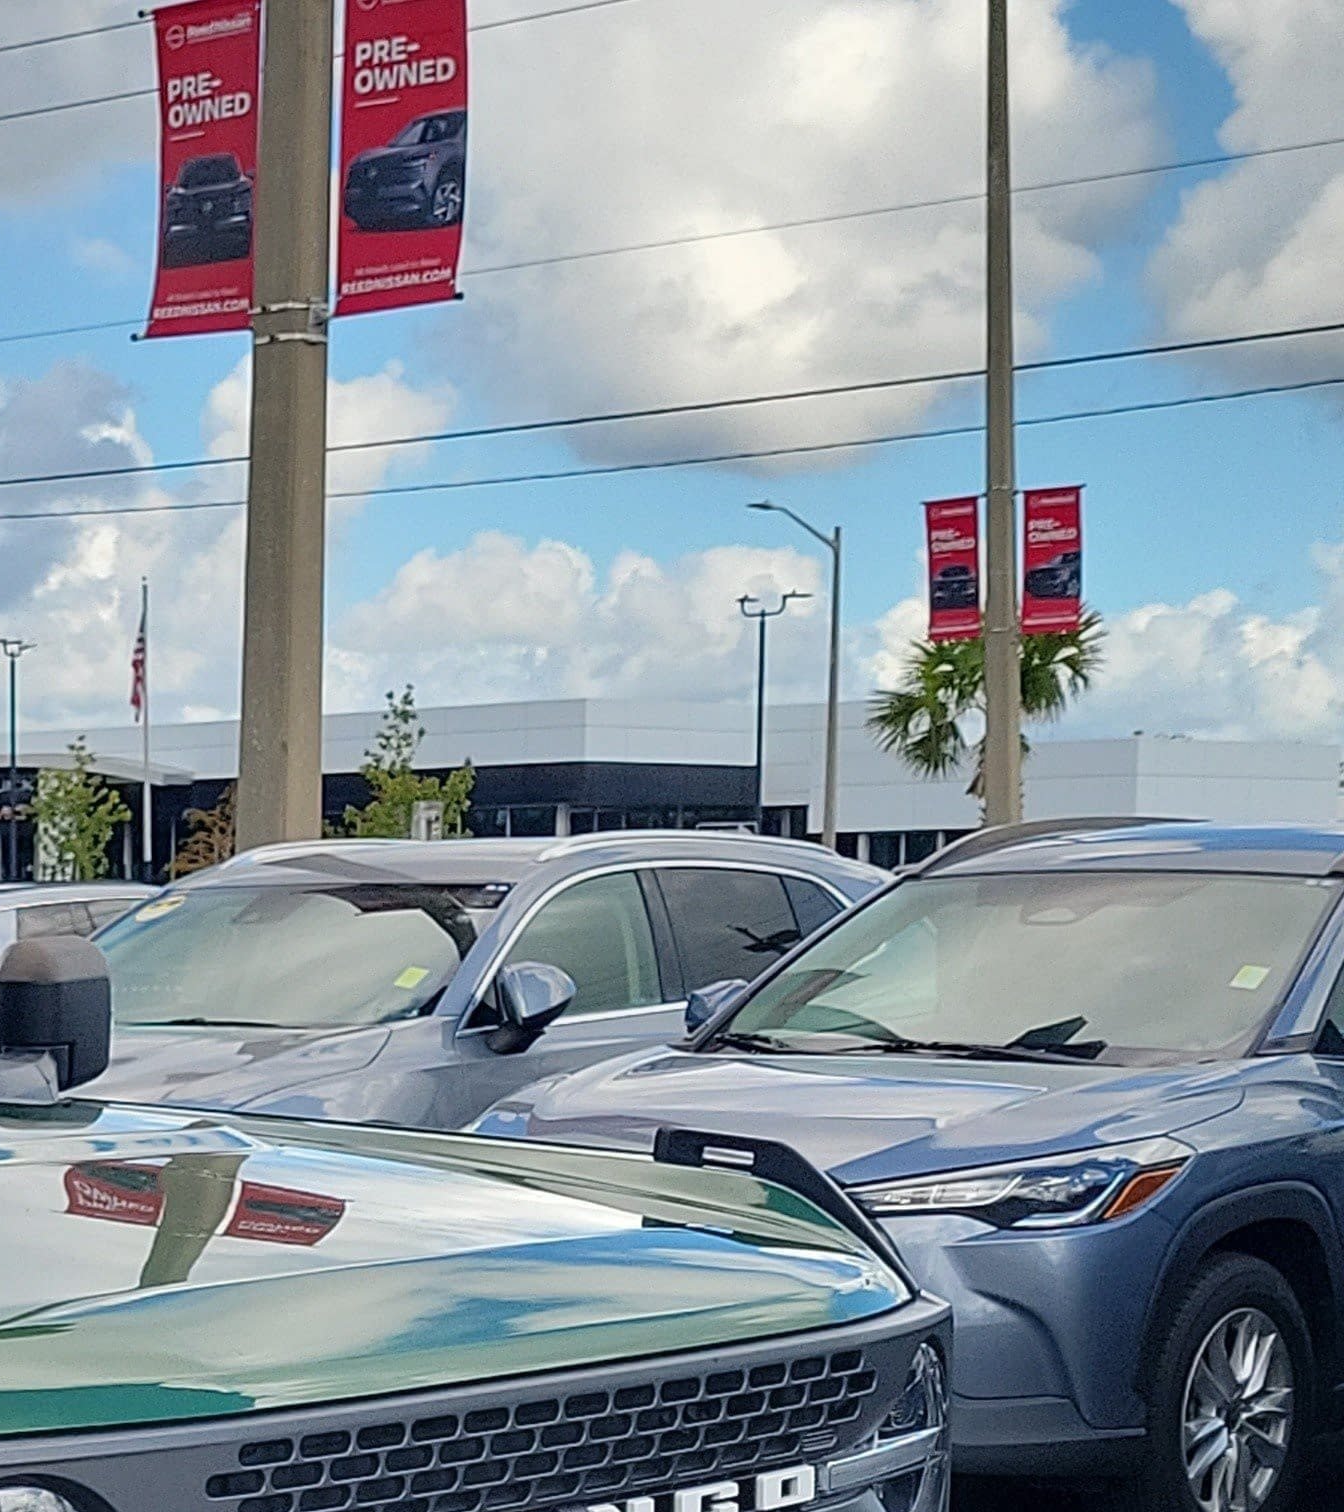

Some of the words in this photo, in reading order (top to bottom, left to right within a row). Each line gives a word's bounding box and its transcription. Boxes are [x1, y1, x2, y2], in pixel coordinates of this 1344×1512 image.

[355, 36, 420, 69] PRE-
[167, 70, 223, 104] PRE-
[354, 58, 456, 94] OWNED
[167, 91, 252, 129] OWNED
